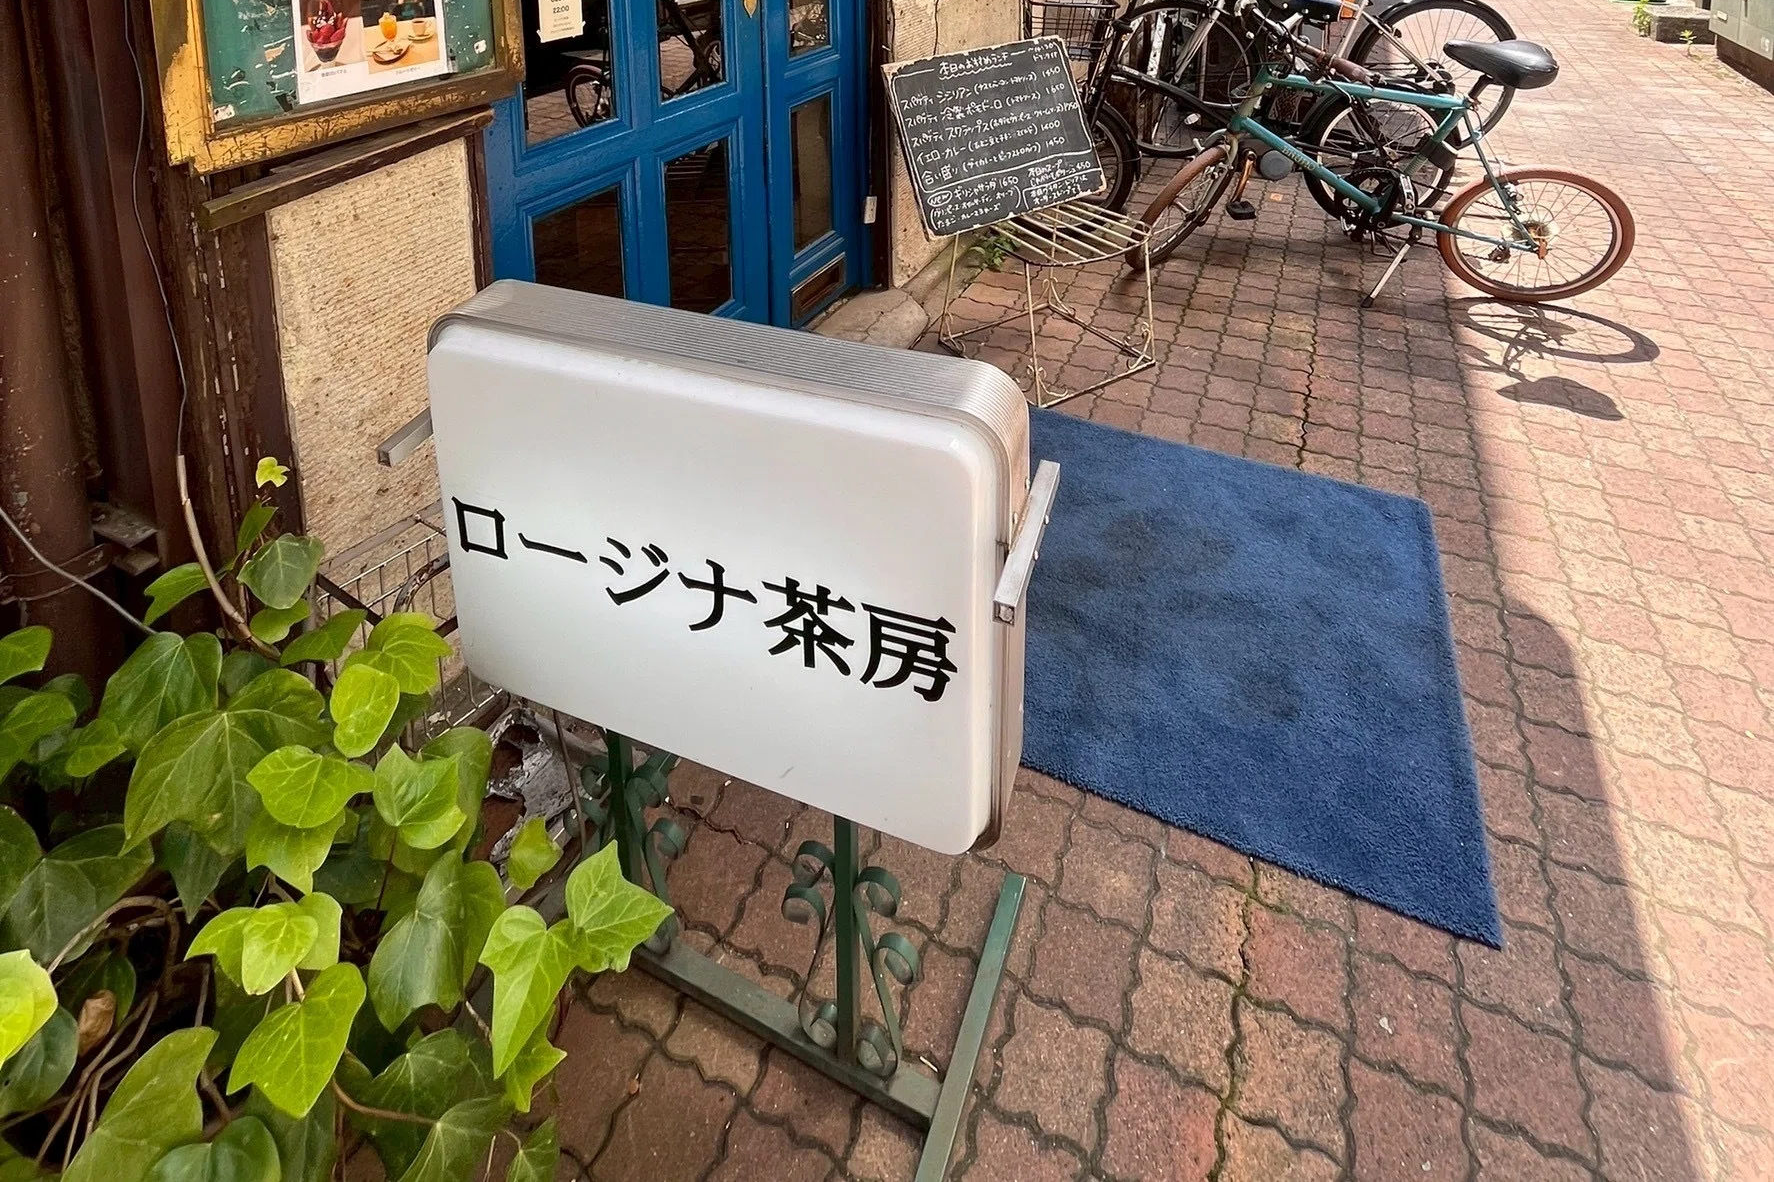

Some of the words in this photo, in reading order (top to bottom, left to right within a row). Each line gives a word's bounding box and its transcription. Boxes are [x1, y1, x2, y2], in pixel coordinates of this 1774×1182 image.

[552, 5, 570, 14] 22:00
[939, 52, 1010, 74] 本日のおすすめランチ
[901, 93, 934, 111] スパゲティ
[936, 86, 972, 103] シシリアン
[905, 113, 939, 129] スパゲティ
[1045, 83, 1066, 95] 1650
[911, 130, 944, 148] スパゲティ
[921, 164, 959, 185] 合い盛り
[1045, 136, 1066, 148] 1450
[999, 175, 1019, 190] 1650
[450, 495, 959, 703] ロージナ茶房
